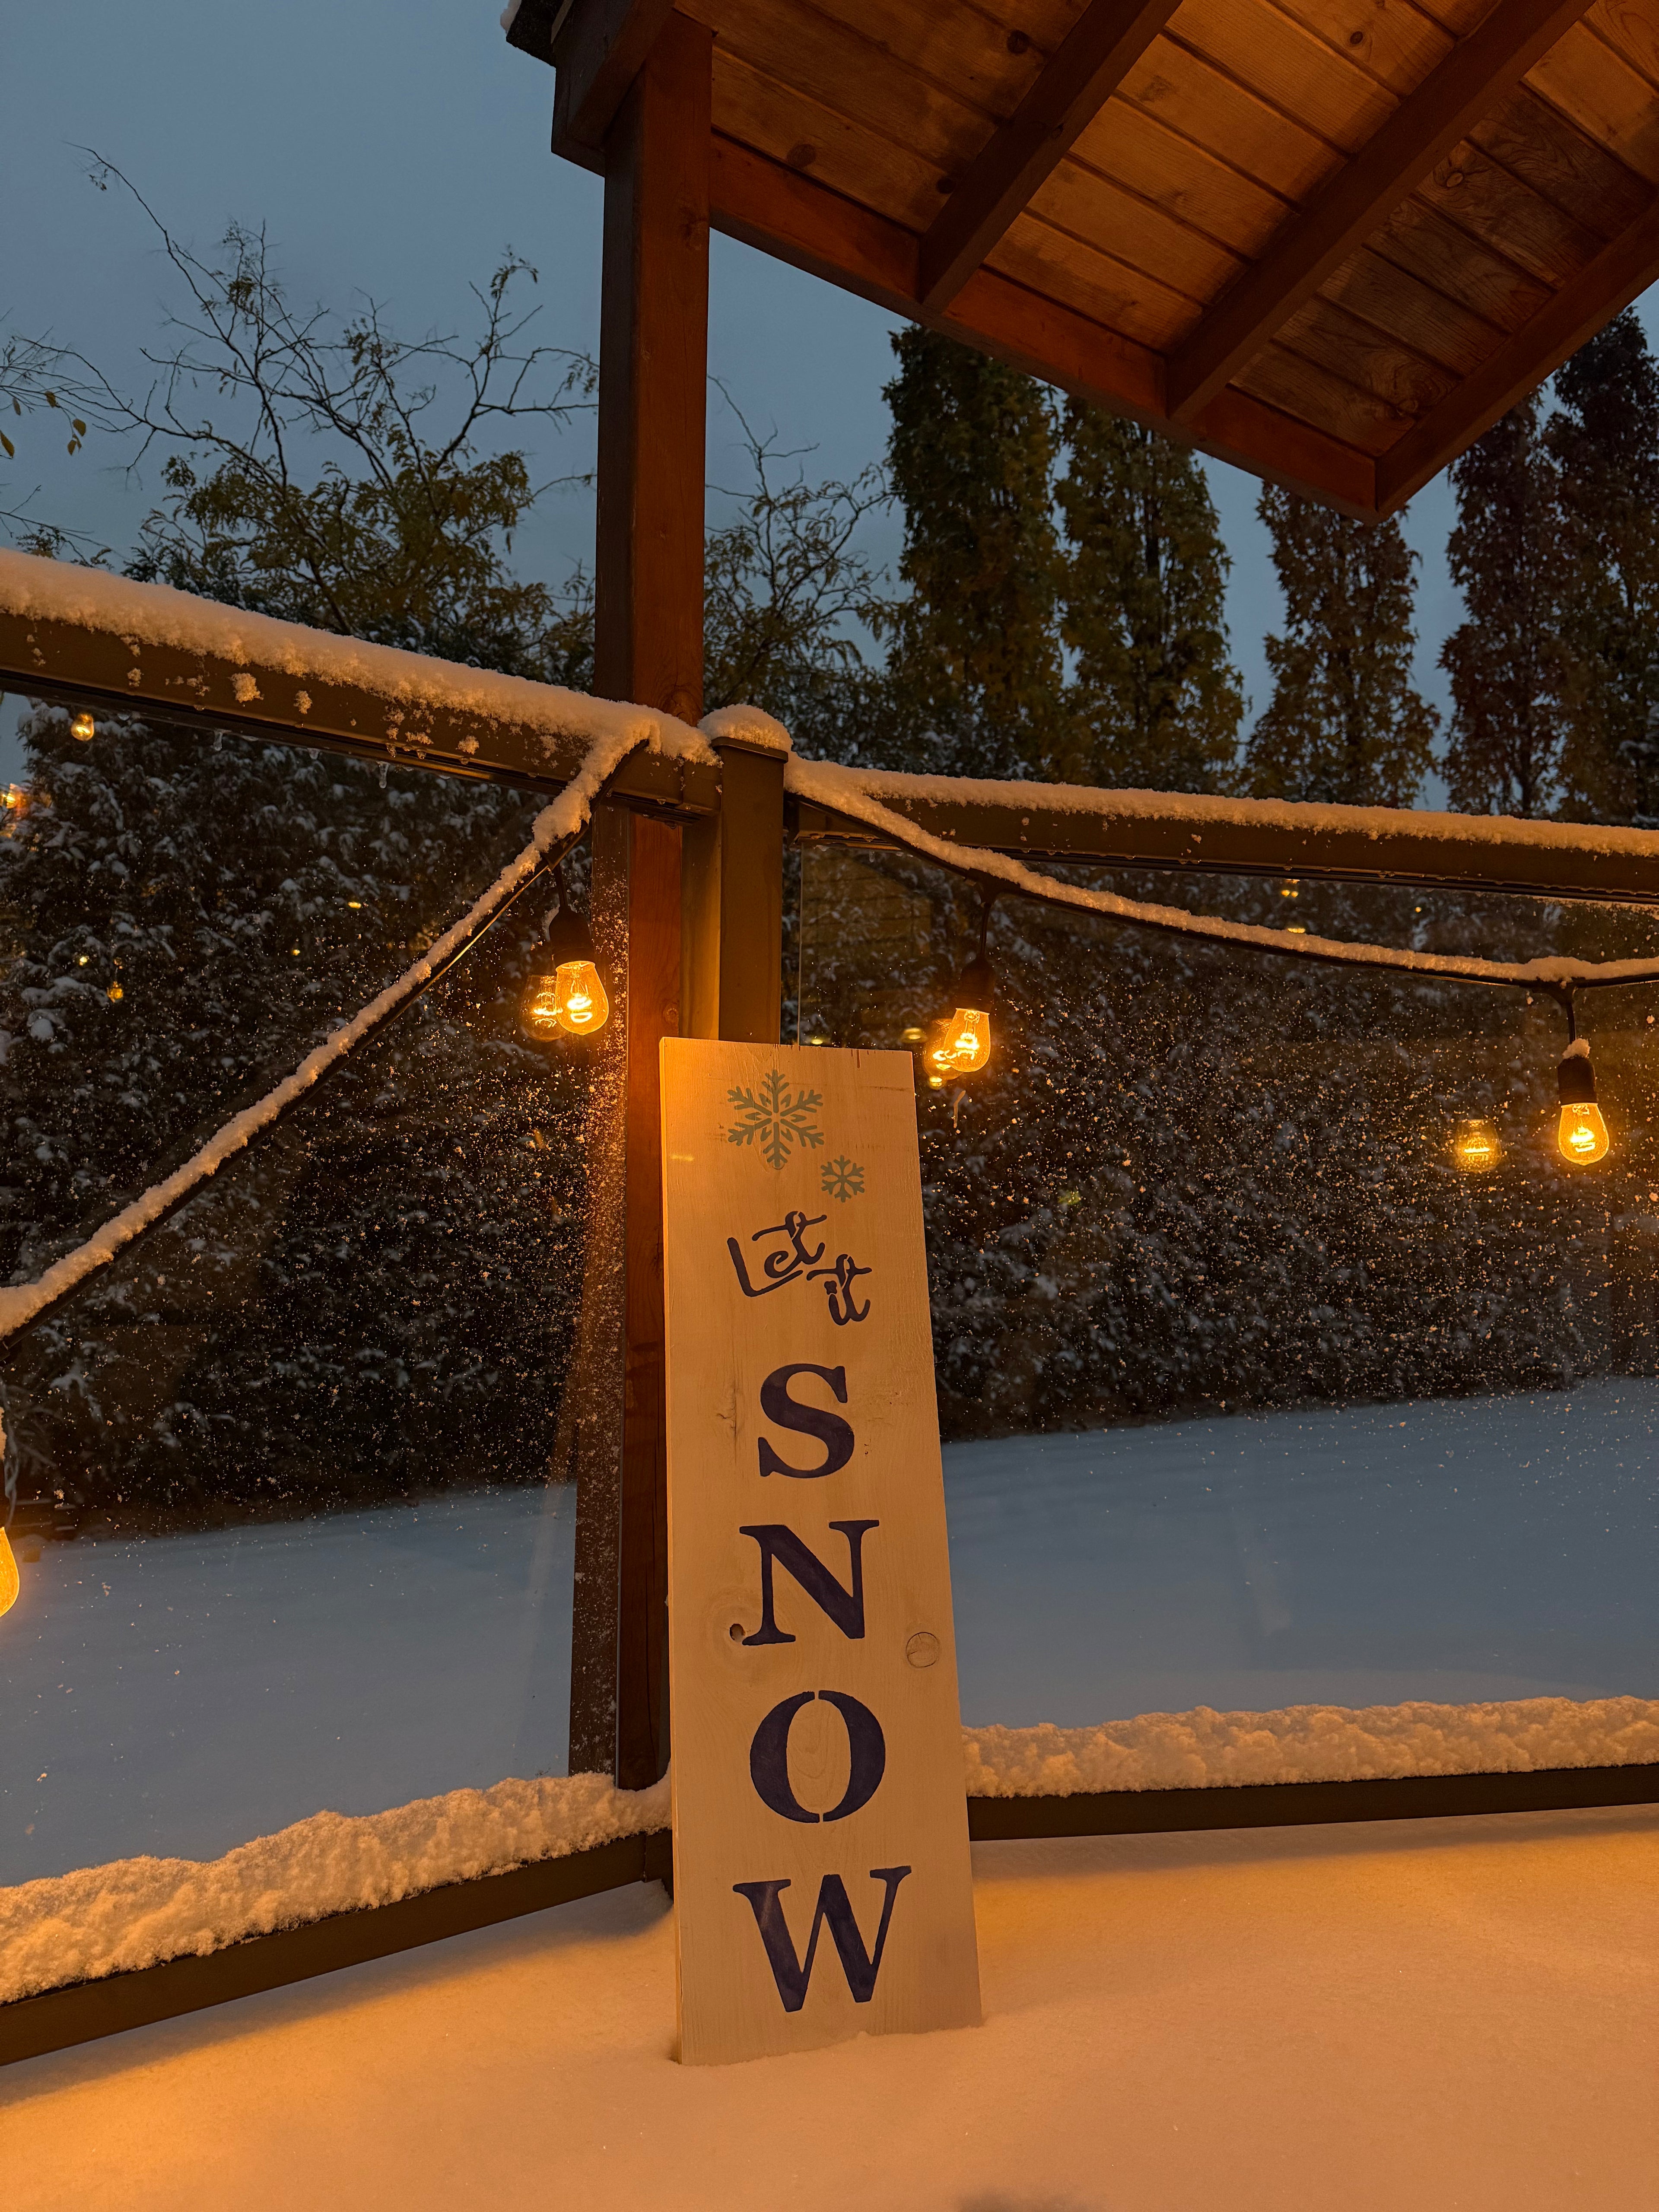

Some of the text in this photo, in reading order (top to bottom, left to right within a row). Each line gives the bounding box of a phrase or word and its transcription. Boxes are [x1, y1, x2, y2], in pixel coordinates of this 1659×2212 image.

[727, 1211, 872, 1326] Let it
[733, 1363, 911, 2012] SNOW
